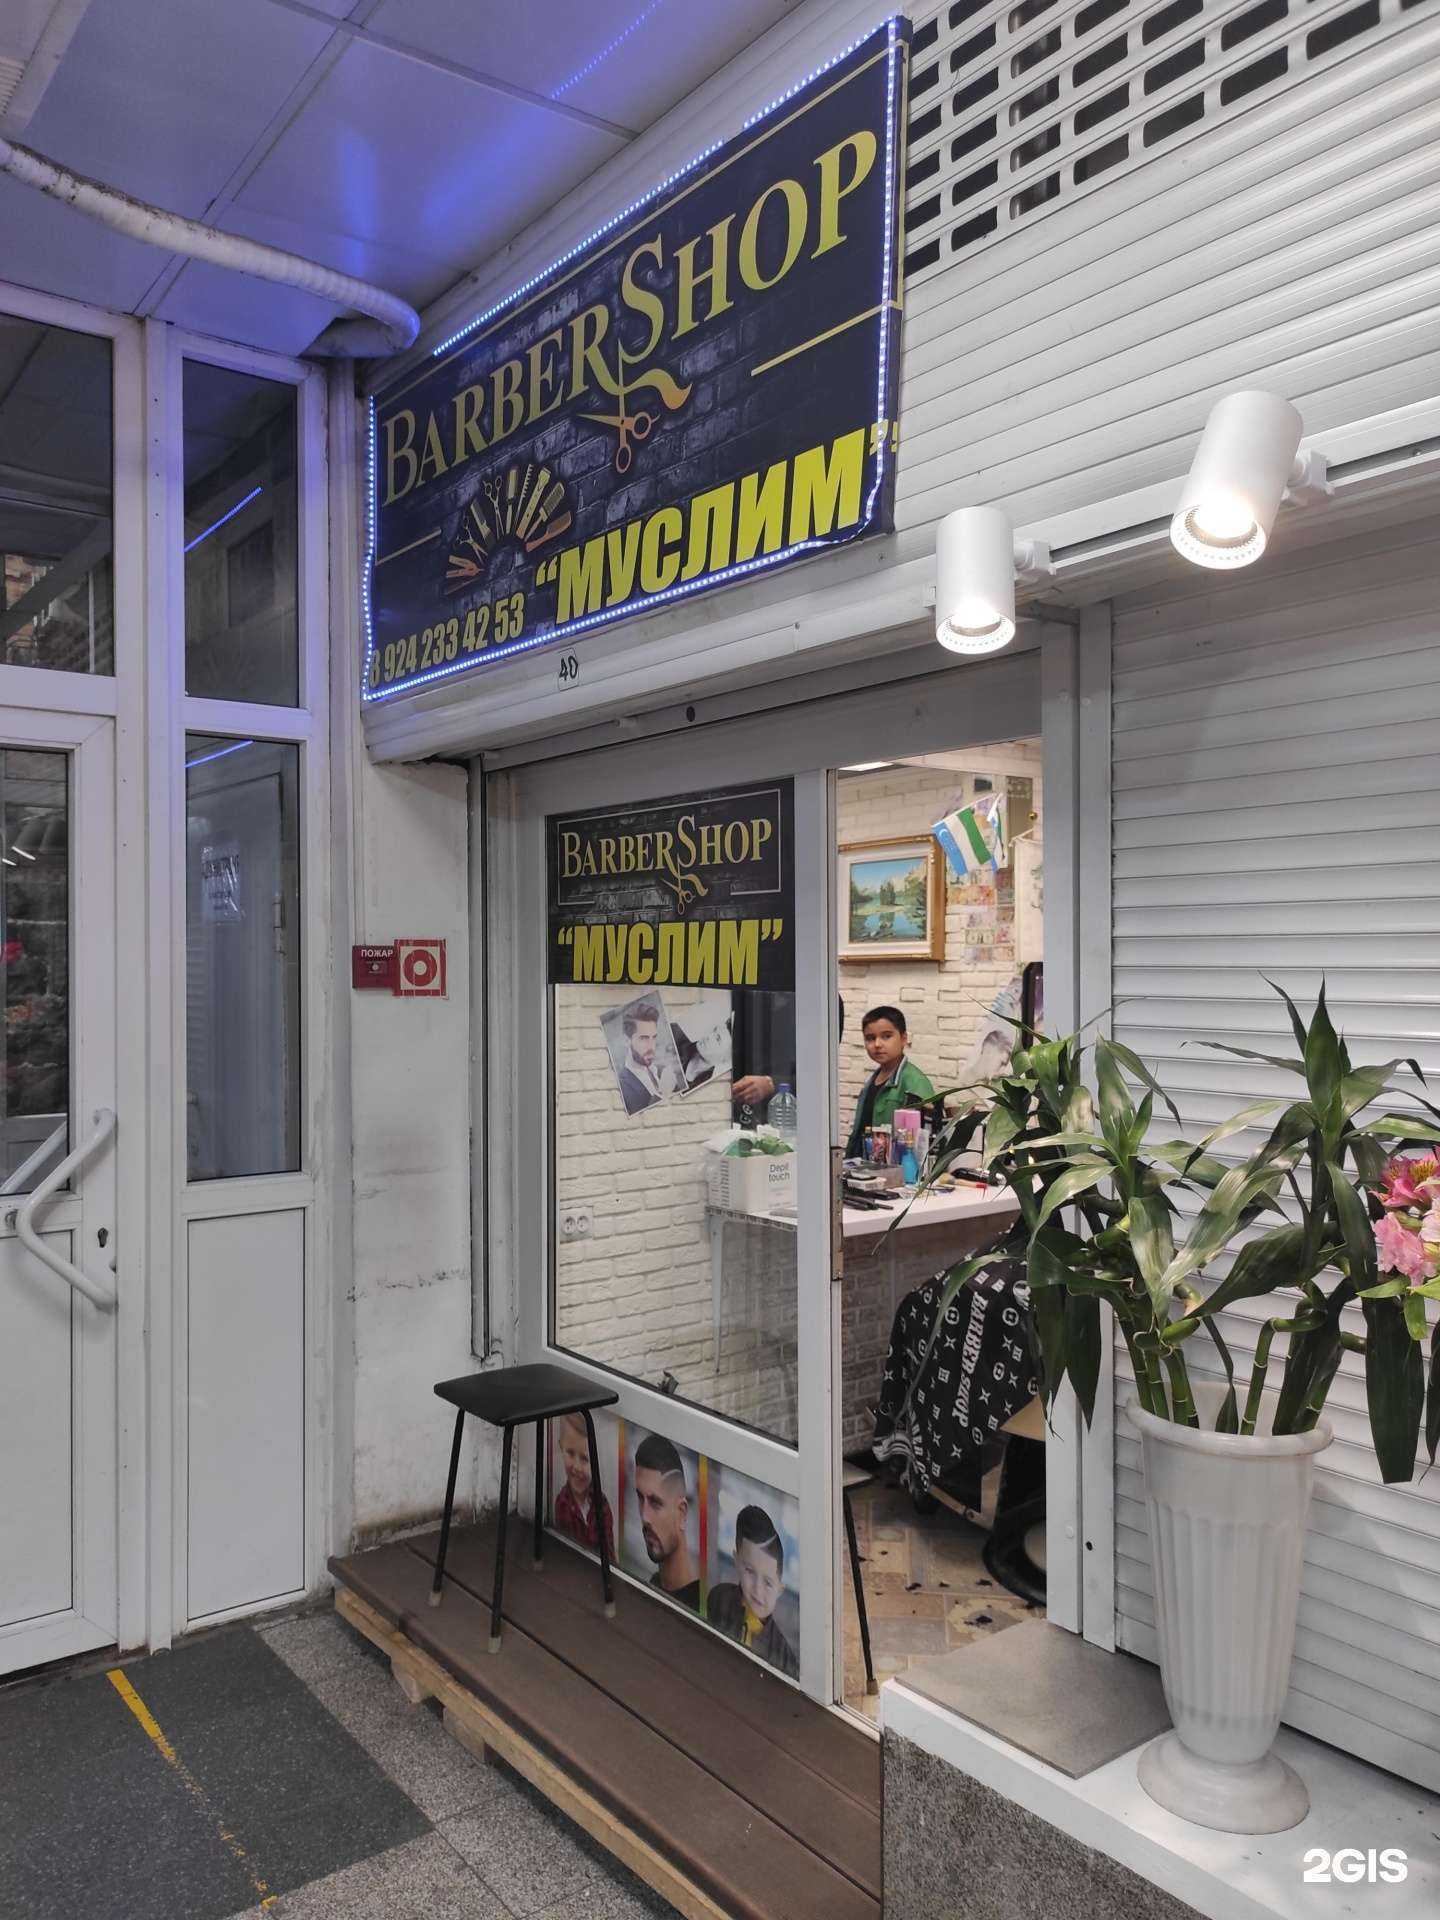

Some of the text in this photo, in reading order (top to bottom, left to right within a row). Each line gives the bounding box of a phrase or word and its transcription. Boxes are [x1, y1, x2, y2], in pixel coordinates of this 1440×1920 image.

[384, 634, 418, 682] 924
[421, 618, 459, 669] 233
[463, 606, 490, 653] 42
[494, 592, 525, 644] 53
[559, 655, 579, 681] 40
[361, 949, 394, 958] ПОЖАР
[951, 1291, 989, 1428] BARBER SHOP
